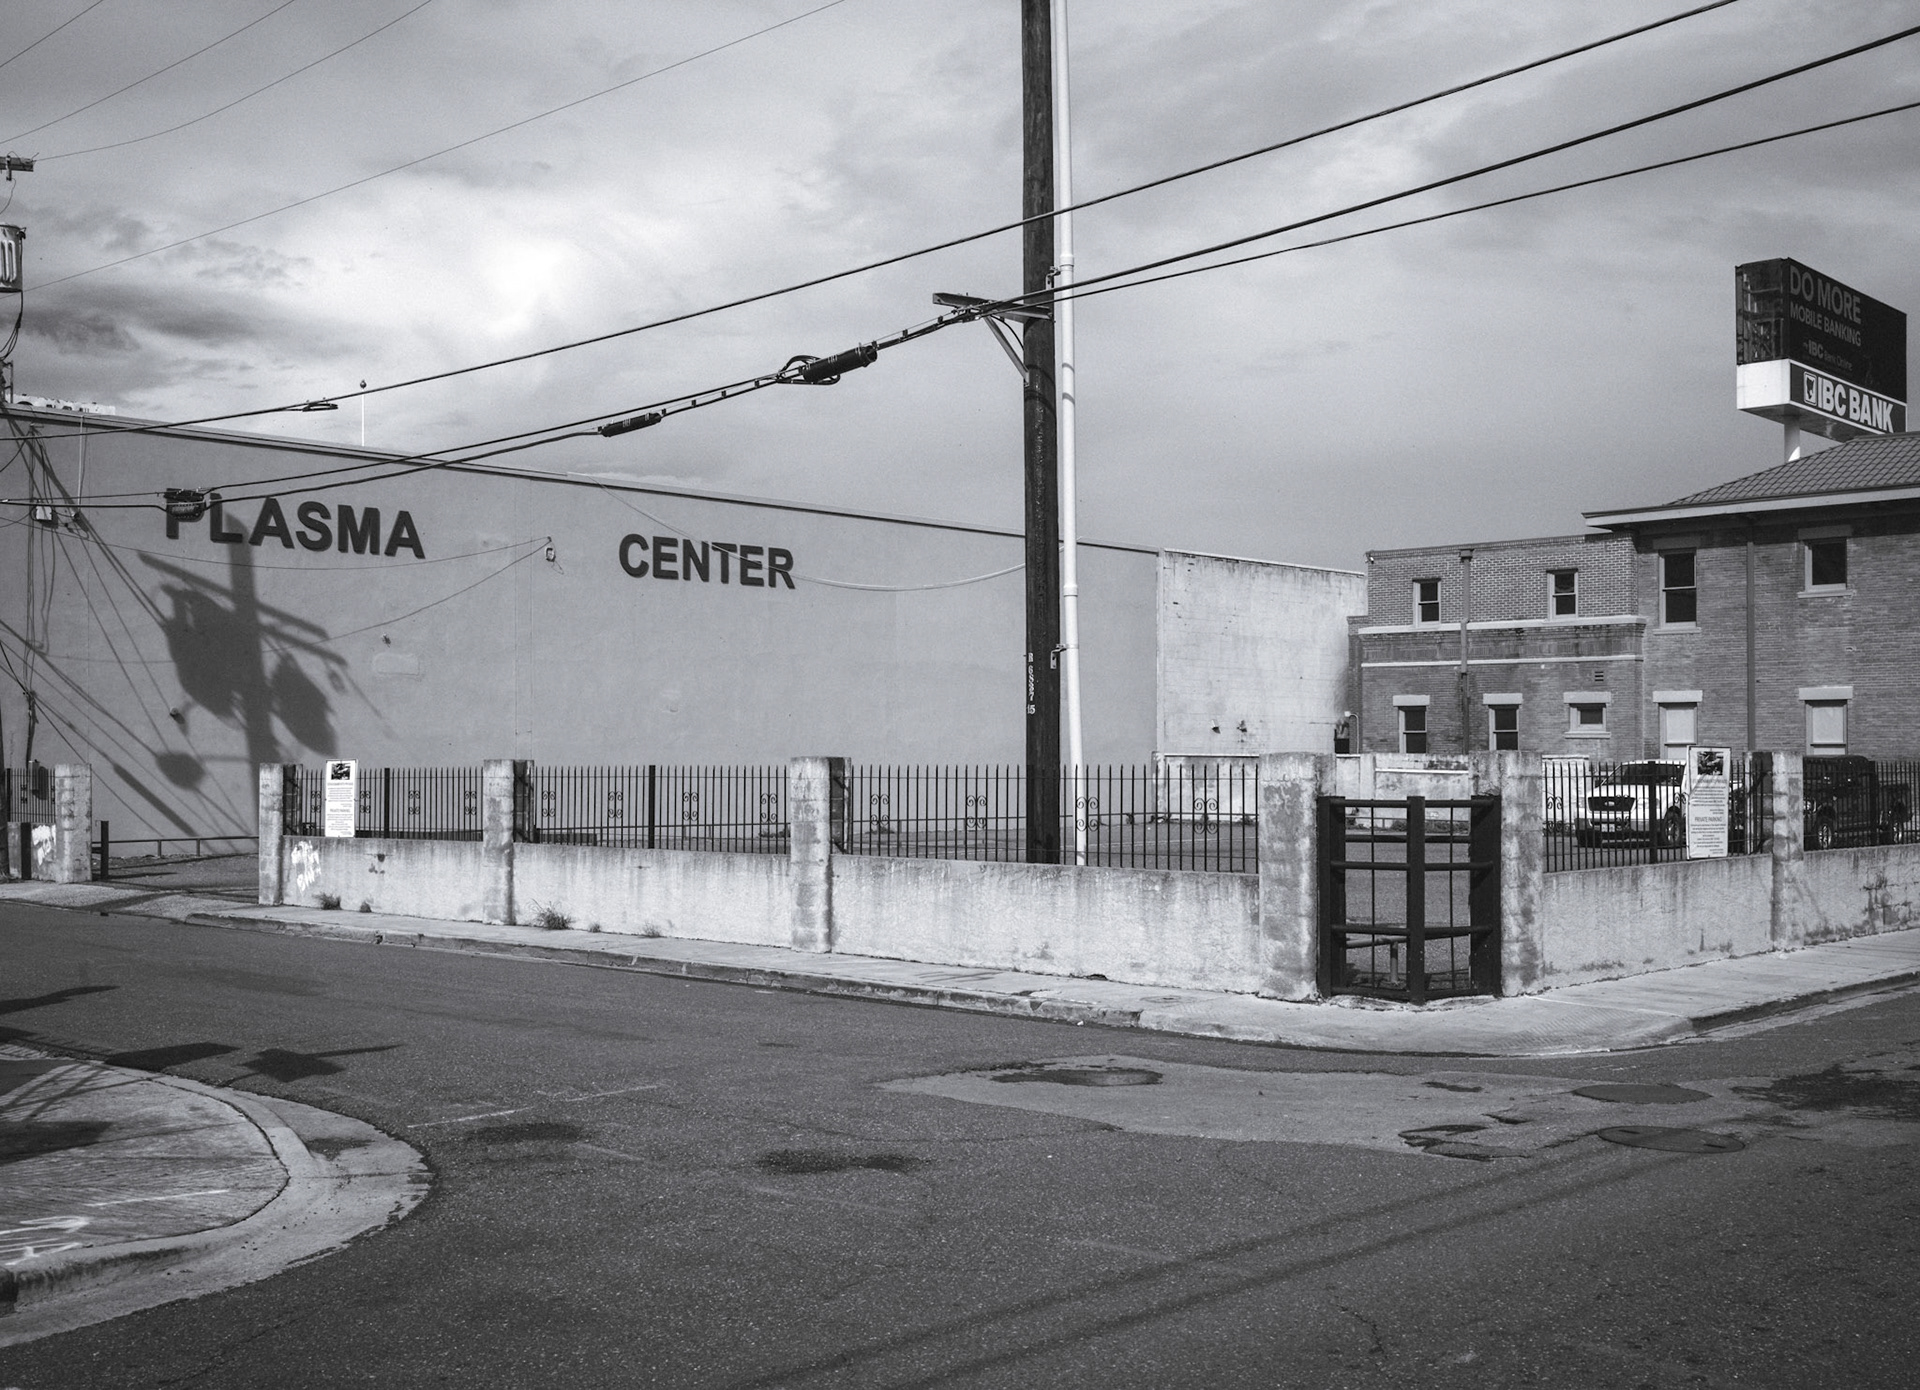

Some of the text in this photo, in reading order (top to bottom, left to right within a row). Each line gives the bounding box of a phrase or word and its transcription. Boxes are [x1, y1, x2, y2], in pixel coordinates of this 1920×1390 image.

[1790, 264, 1861, 324] DO MORE
[1790, 302, 1861, 347] MOBILE BANKING
[1808, 339, 1823, 359] IBC
[1818, 377, 1894, 433] IBC BANK
[166, 488, 796, 589] PLASMA CENTER
